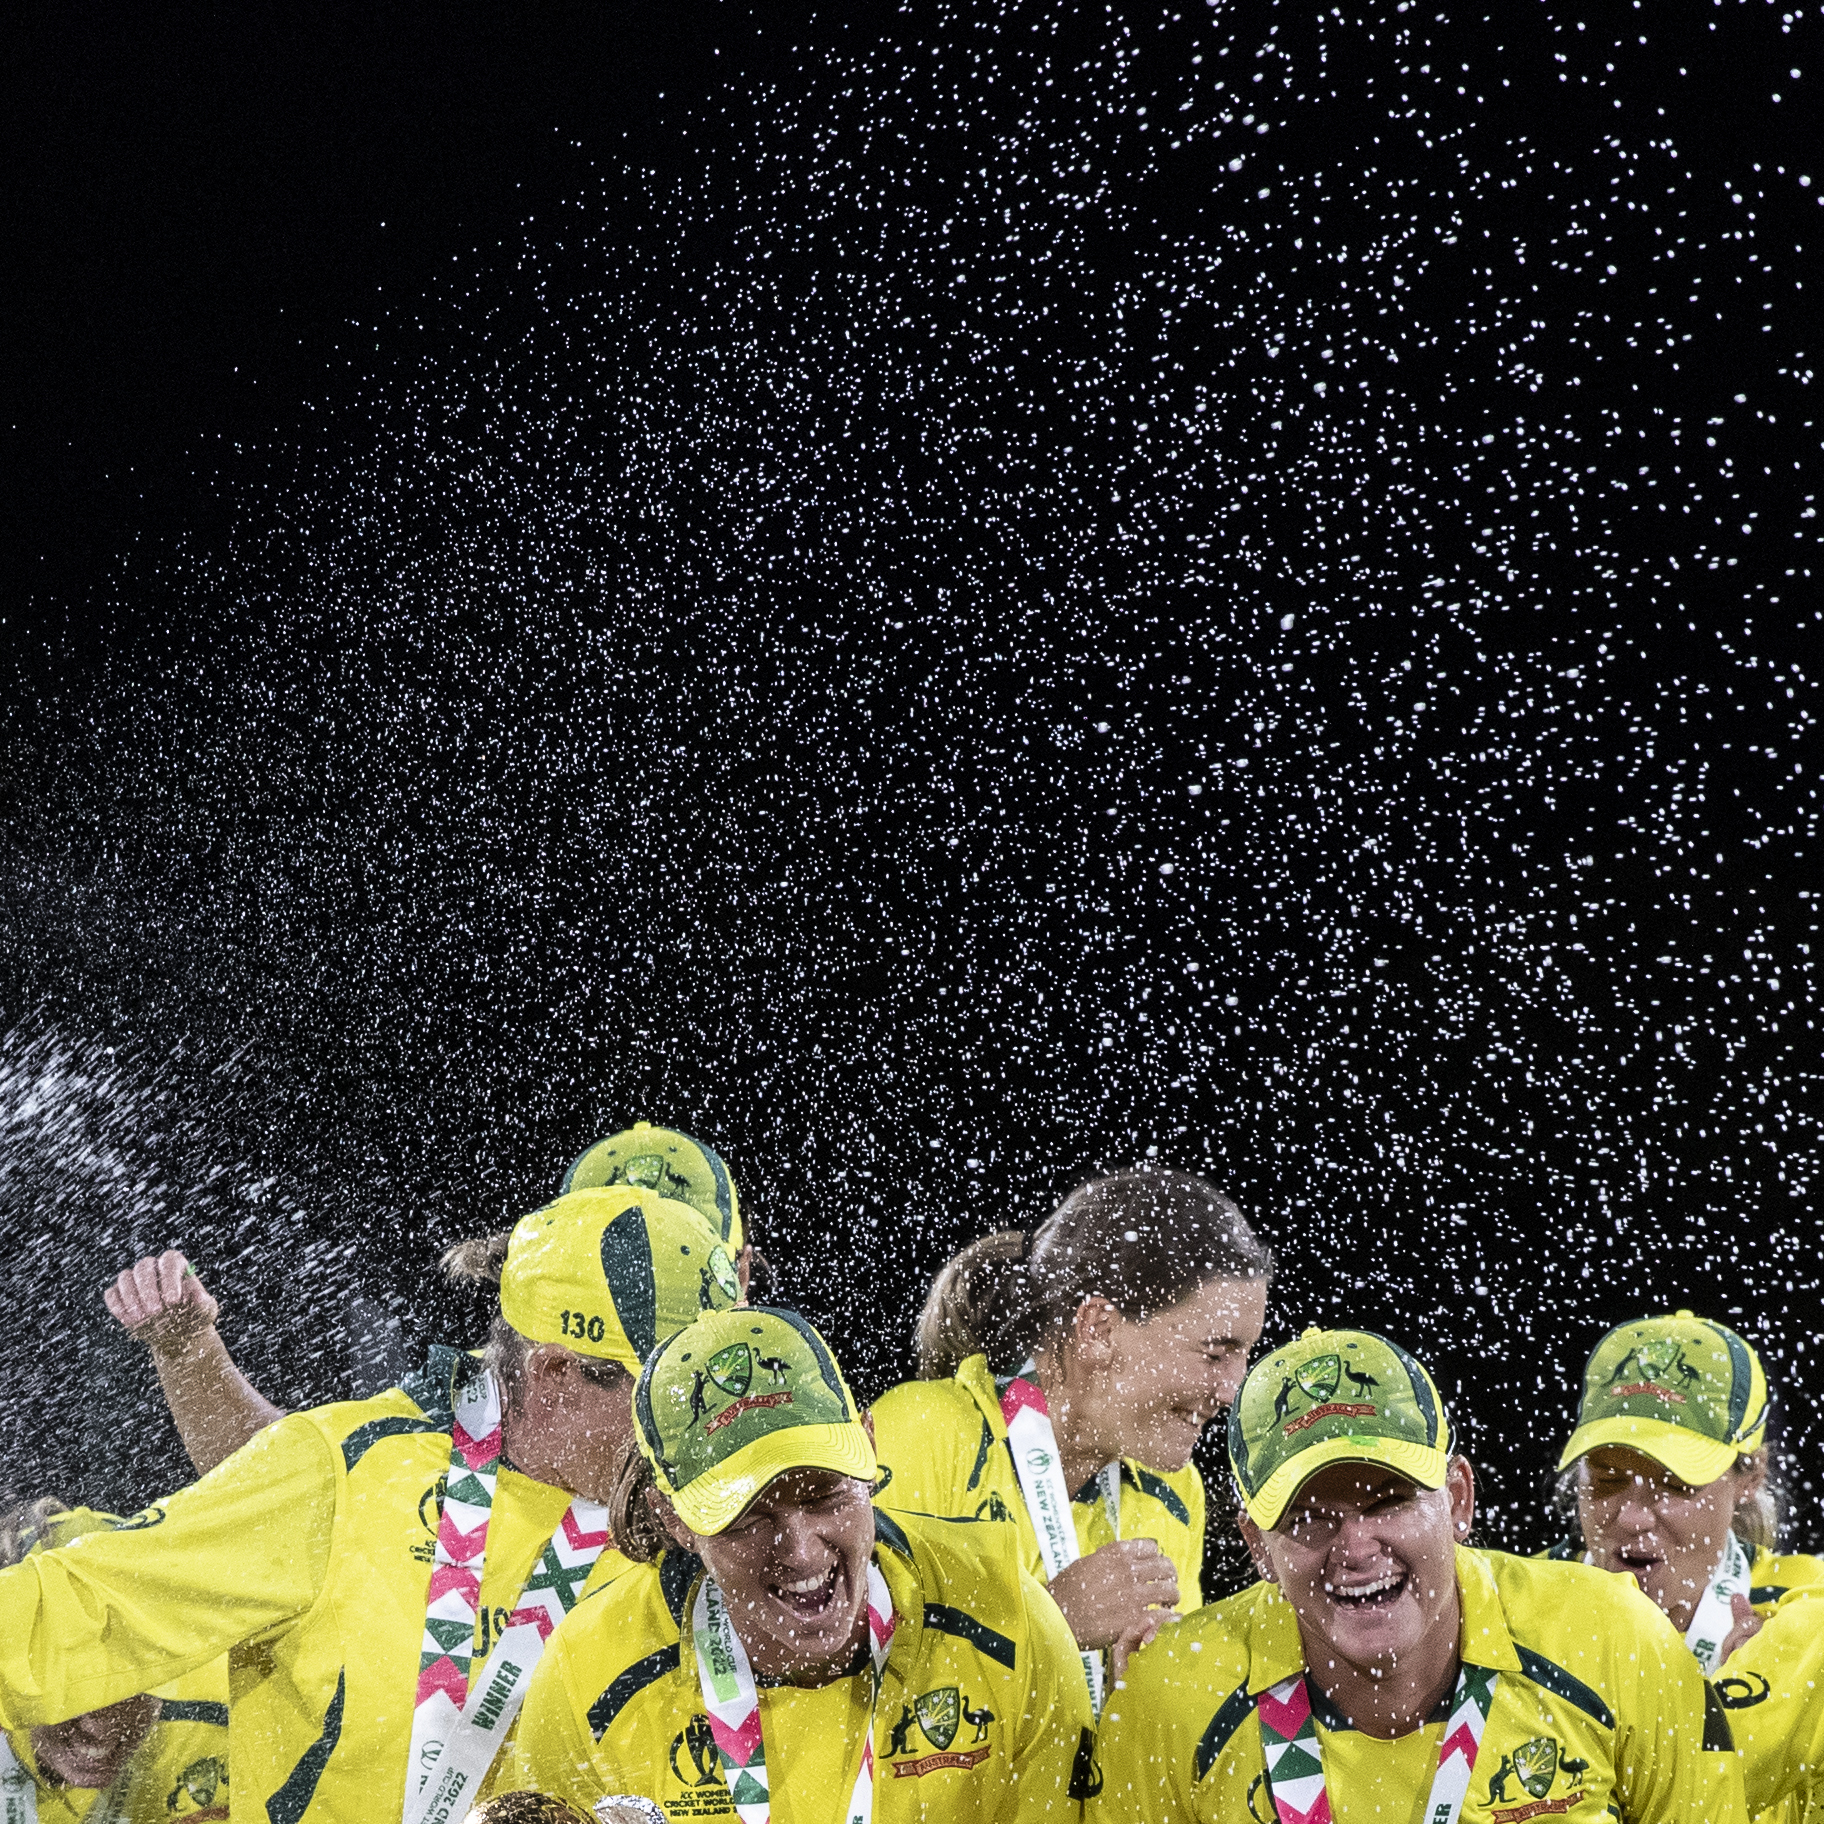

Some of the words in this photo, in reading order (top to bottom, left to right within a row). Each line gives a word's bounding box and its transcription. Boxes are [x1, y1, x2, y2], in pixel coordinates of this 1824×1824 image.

[559, 1309, 606, 1343] 130
[1034, 1479, 1050, 1511] NEW
[1042, 1515, 1064, 1574] ZEALAN
[708, 1635, 727, 1677] 2022
[470, 1659, 524, 1732] WINNER
[426, 1784, 446, 1816] WORLD
[442, 1766, 455, 1785] CUP
[443, 1771, 470, 1808] 2022
[663, 1798, 702, 1810] CRICKET
[695, 1788, 733, 1800] WOMEN
[669, 1806, 690, 1818] NEW
